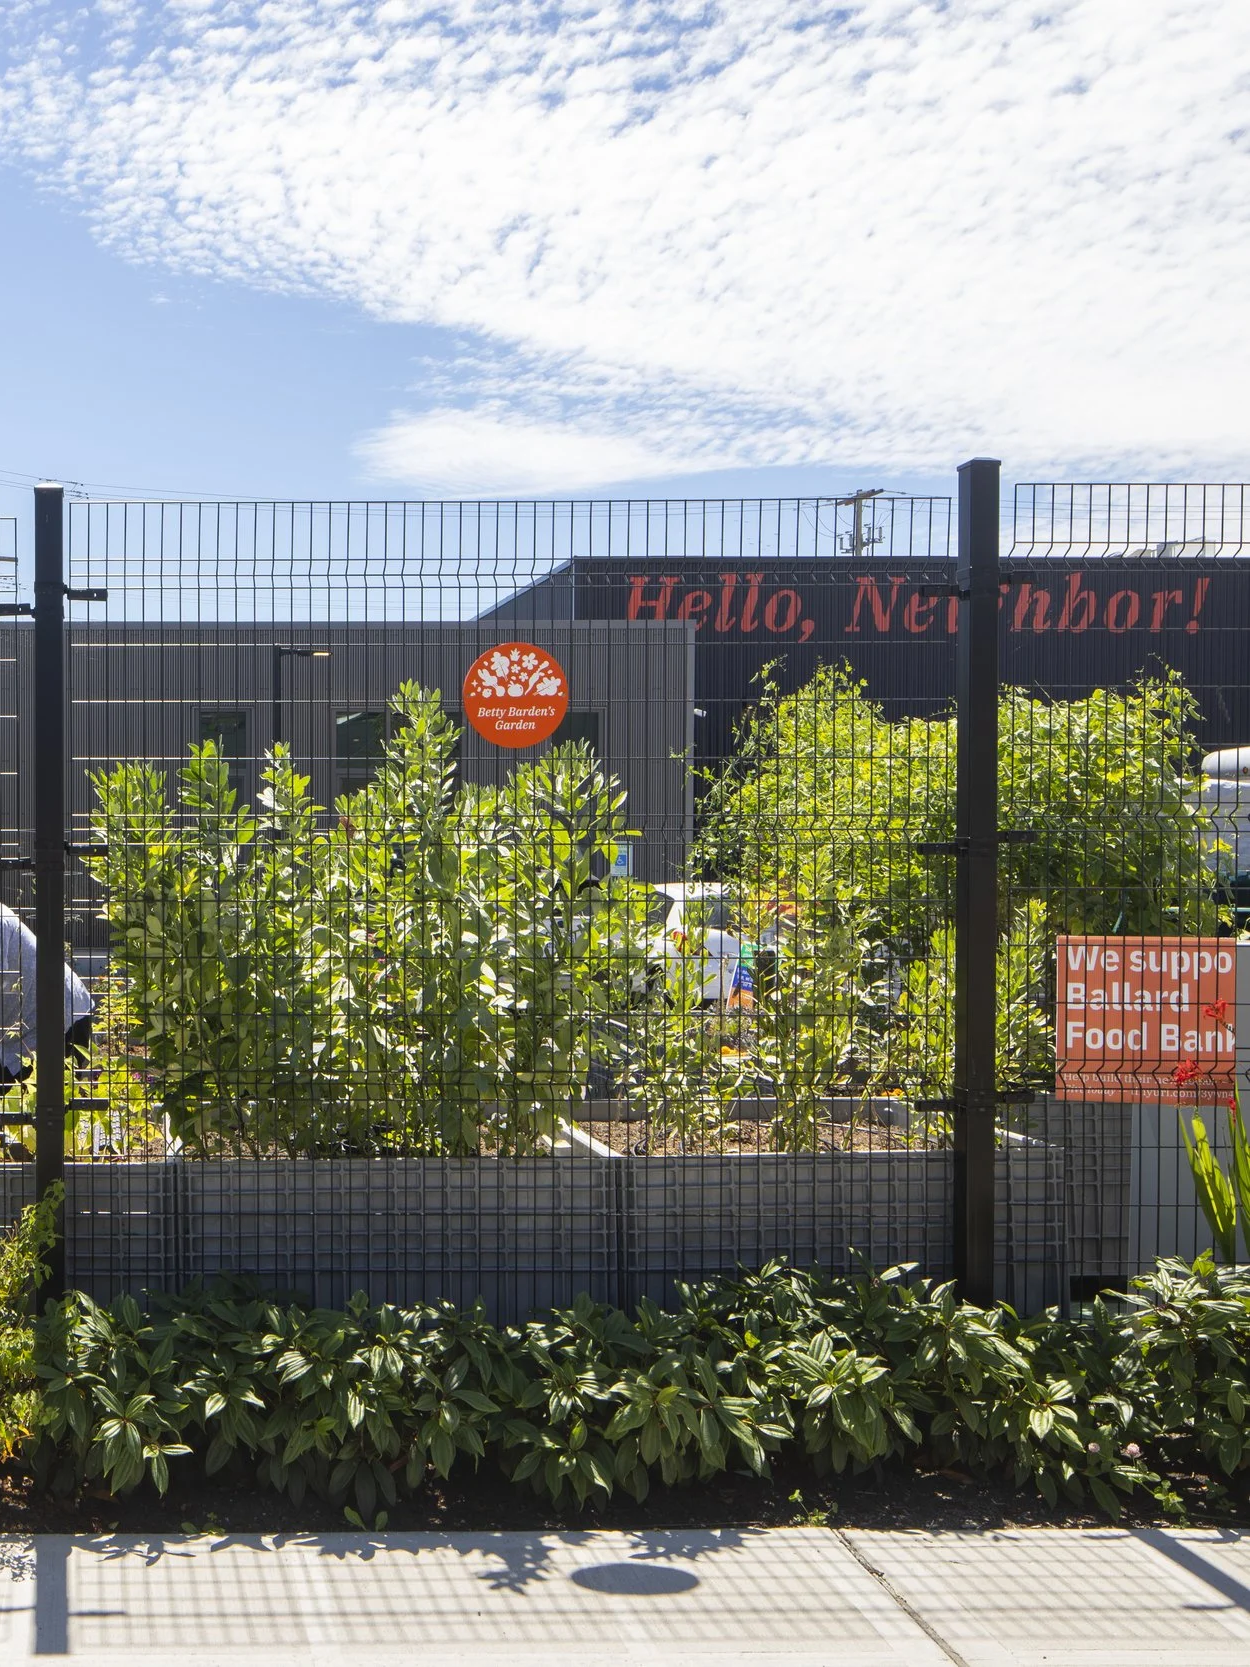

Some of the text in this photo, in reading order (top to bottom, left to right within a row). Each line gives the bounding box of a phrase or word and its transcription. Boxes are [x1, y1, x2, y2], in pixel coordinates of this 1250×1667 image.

[627, 572, 1210, 643] Hello, Nehbor!
[477, 706, 556, 719] Betty Barden's
[495, 720, 536, 731] Garden
[1067, 945, 1120, 972] We
[1067, 981, 1190, 1012] Ballard
[1067, 1021, 1148, 1050] Food
[1124, 1073, 1151, 1084] their
